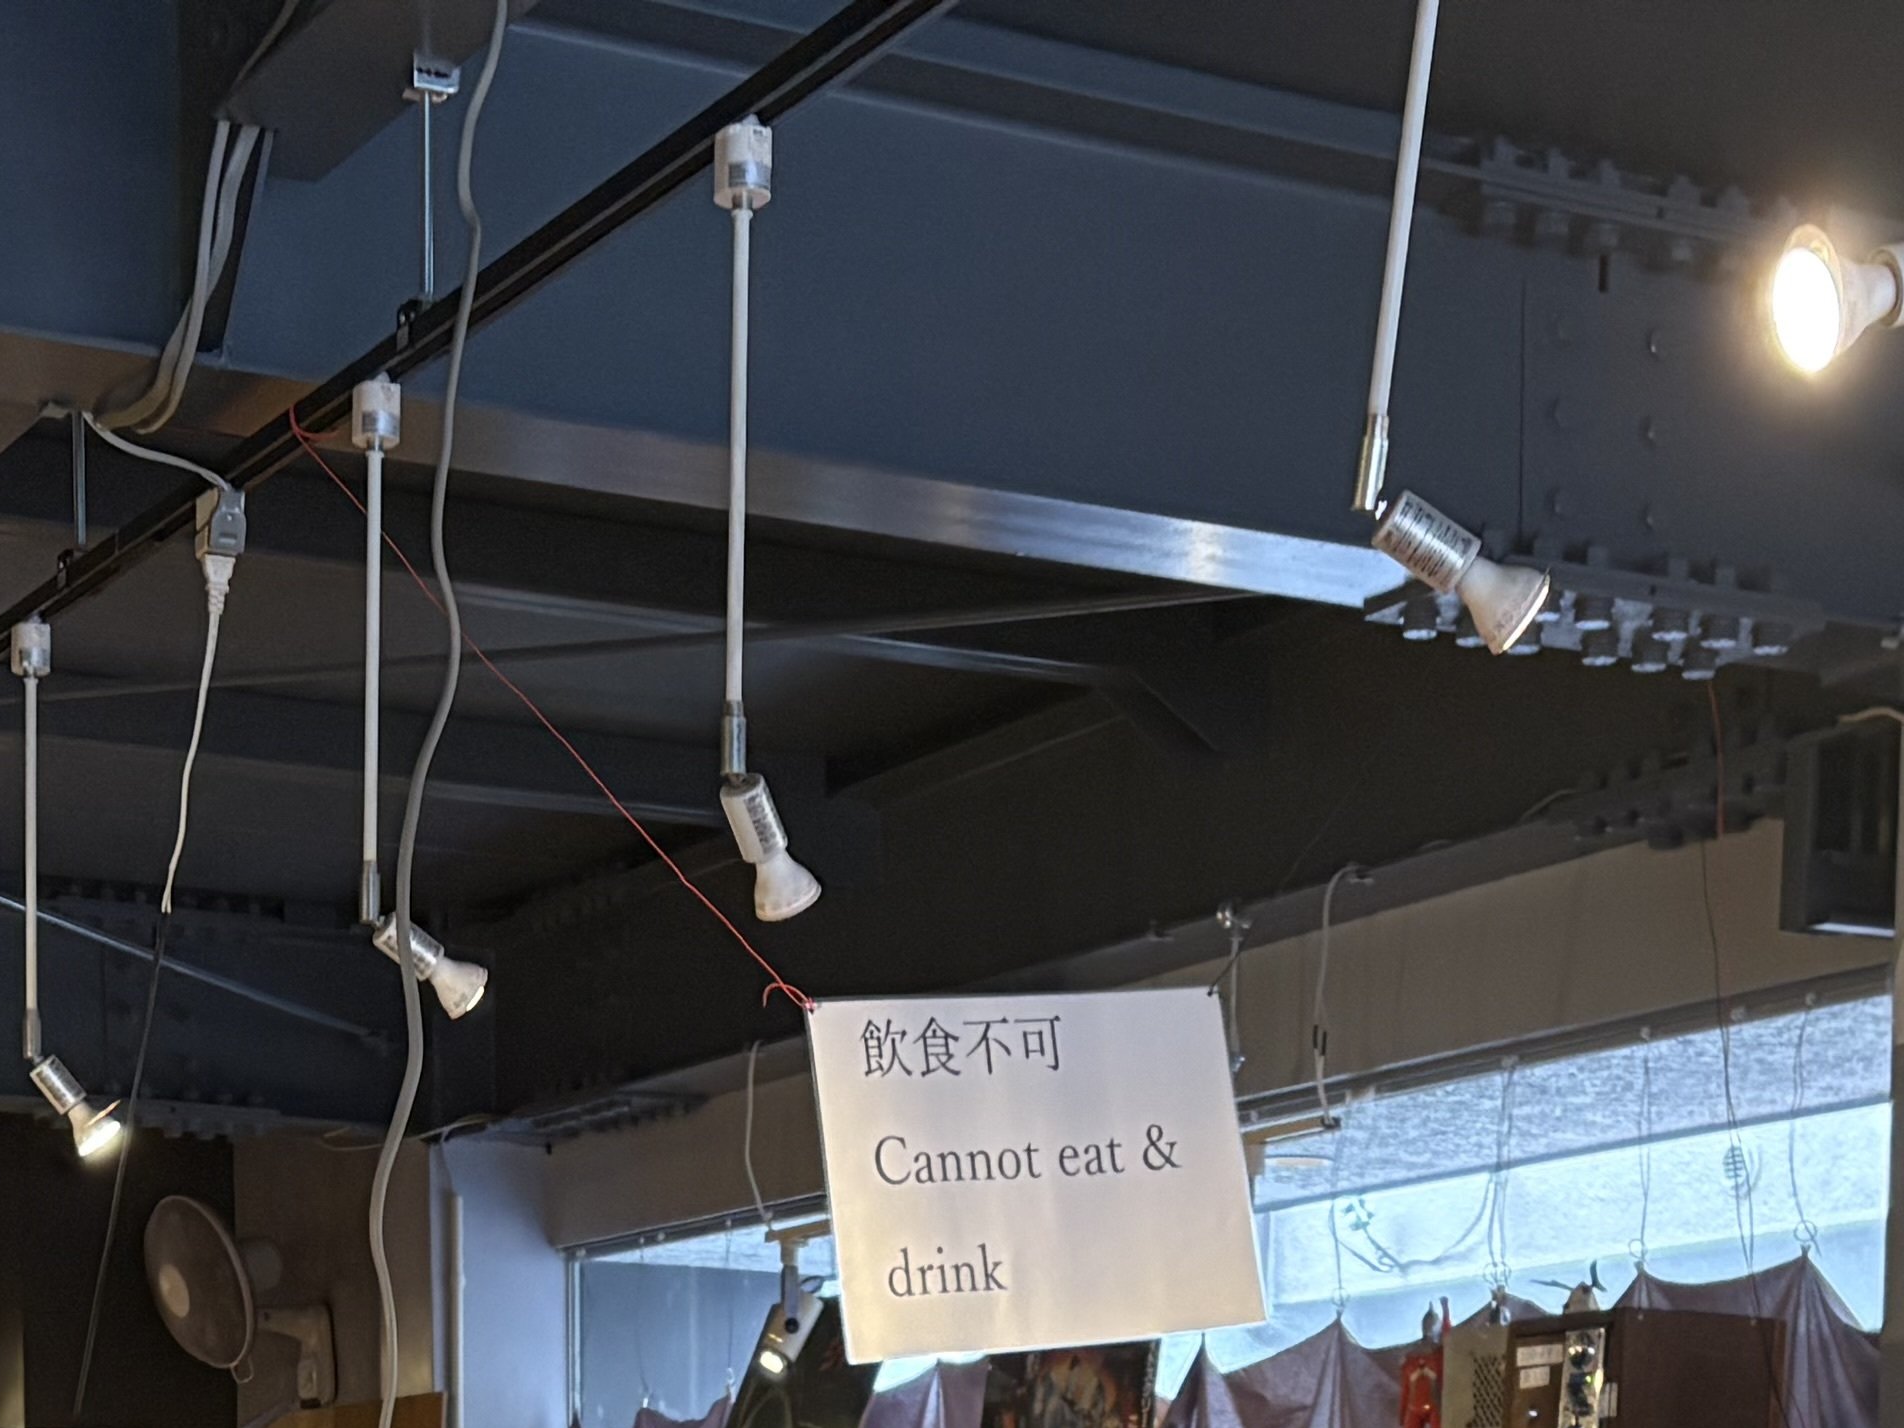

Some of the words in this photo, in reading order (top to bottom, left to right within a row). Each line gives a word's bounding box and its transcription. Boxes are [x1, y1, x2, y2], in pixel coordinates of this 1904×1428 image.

[860, 1015, 1061, 1078] 飲食不可
[875, 1135, 1041, 1186] Cannot
[1058, 1137, 1125, 1177] eat
[1142, 1123, 1183, 1172] &
[887, 1242, 1008, 1298] drink
